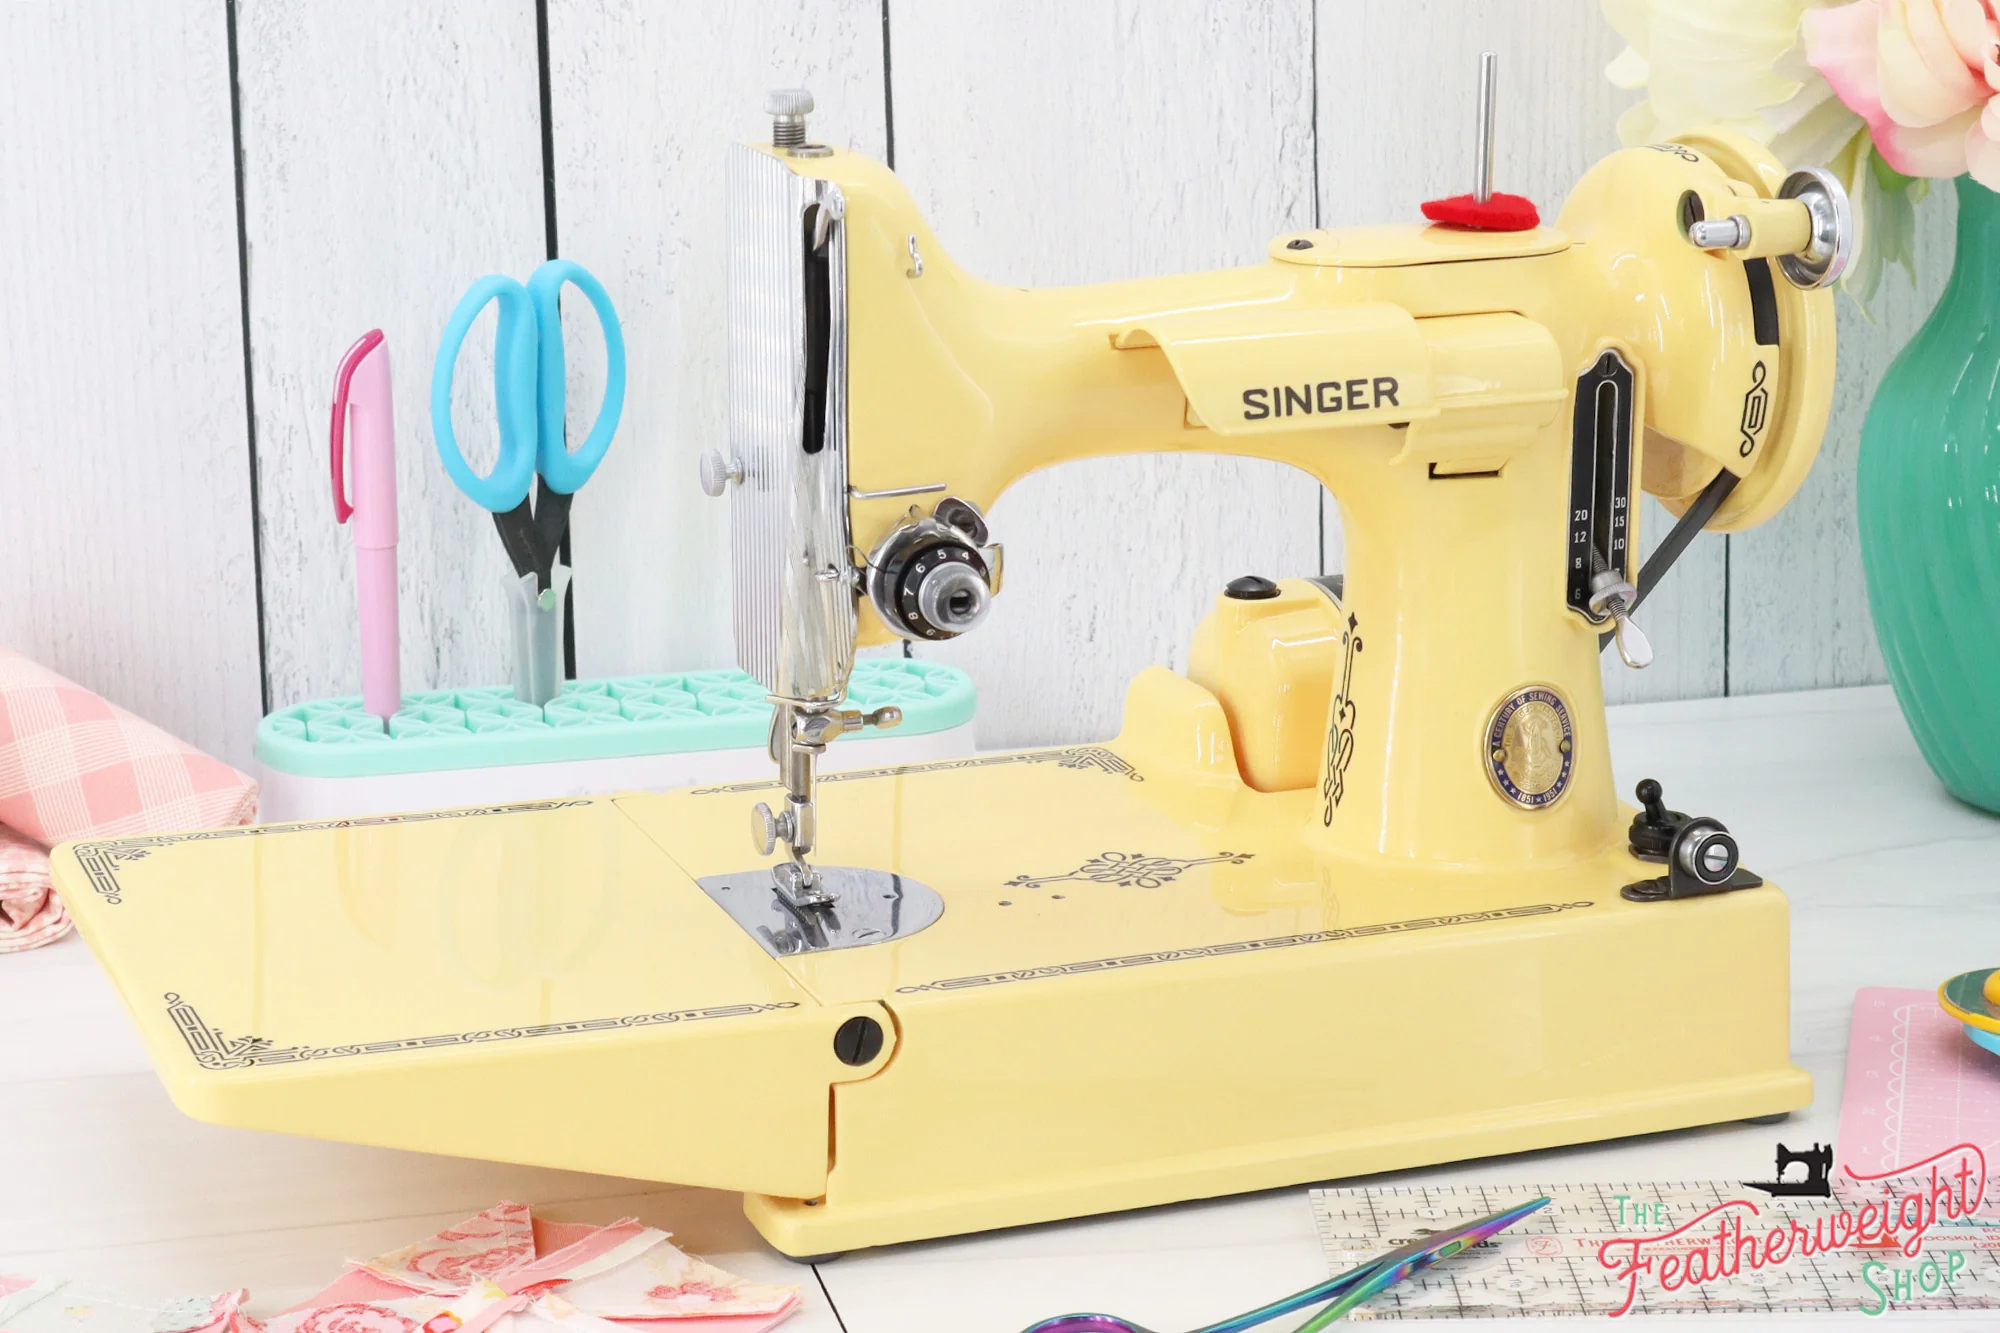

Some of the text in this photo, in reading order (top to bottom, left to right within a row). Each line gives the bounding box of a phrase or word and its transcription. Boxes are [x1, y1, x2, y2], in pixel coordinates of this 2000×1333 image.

[1242, 376, 1399, 420] SINGER
[1614, 496, 1627, 509] 30
[1574, 509, 1588, 522] 20
[1614, 515, 1625, 527] 15
[1573, 531, 1587, 543] 12
[1613, 538, 1625, 550] 10
[937, 549, 947, 560] 5
[961, 551, 970, 560] 4
[915, 563, 926, 574] 6
[1575, 557, 1582, 569] 8
[904, 587, 915, 597] 7
[1574, 588, 1582, 600] 6
[908, 611, 919, 621] 8
[1494, 704, 1515, 738] CENTURY
[1516, 694, 1527, 707] OF
[1528, 691, 1557, 707] SEWING
[1555, 704, 1571, 737] SERVICE
[1517, 787, 1558, 804] 1851 1951
